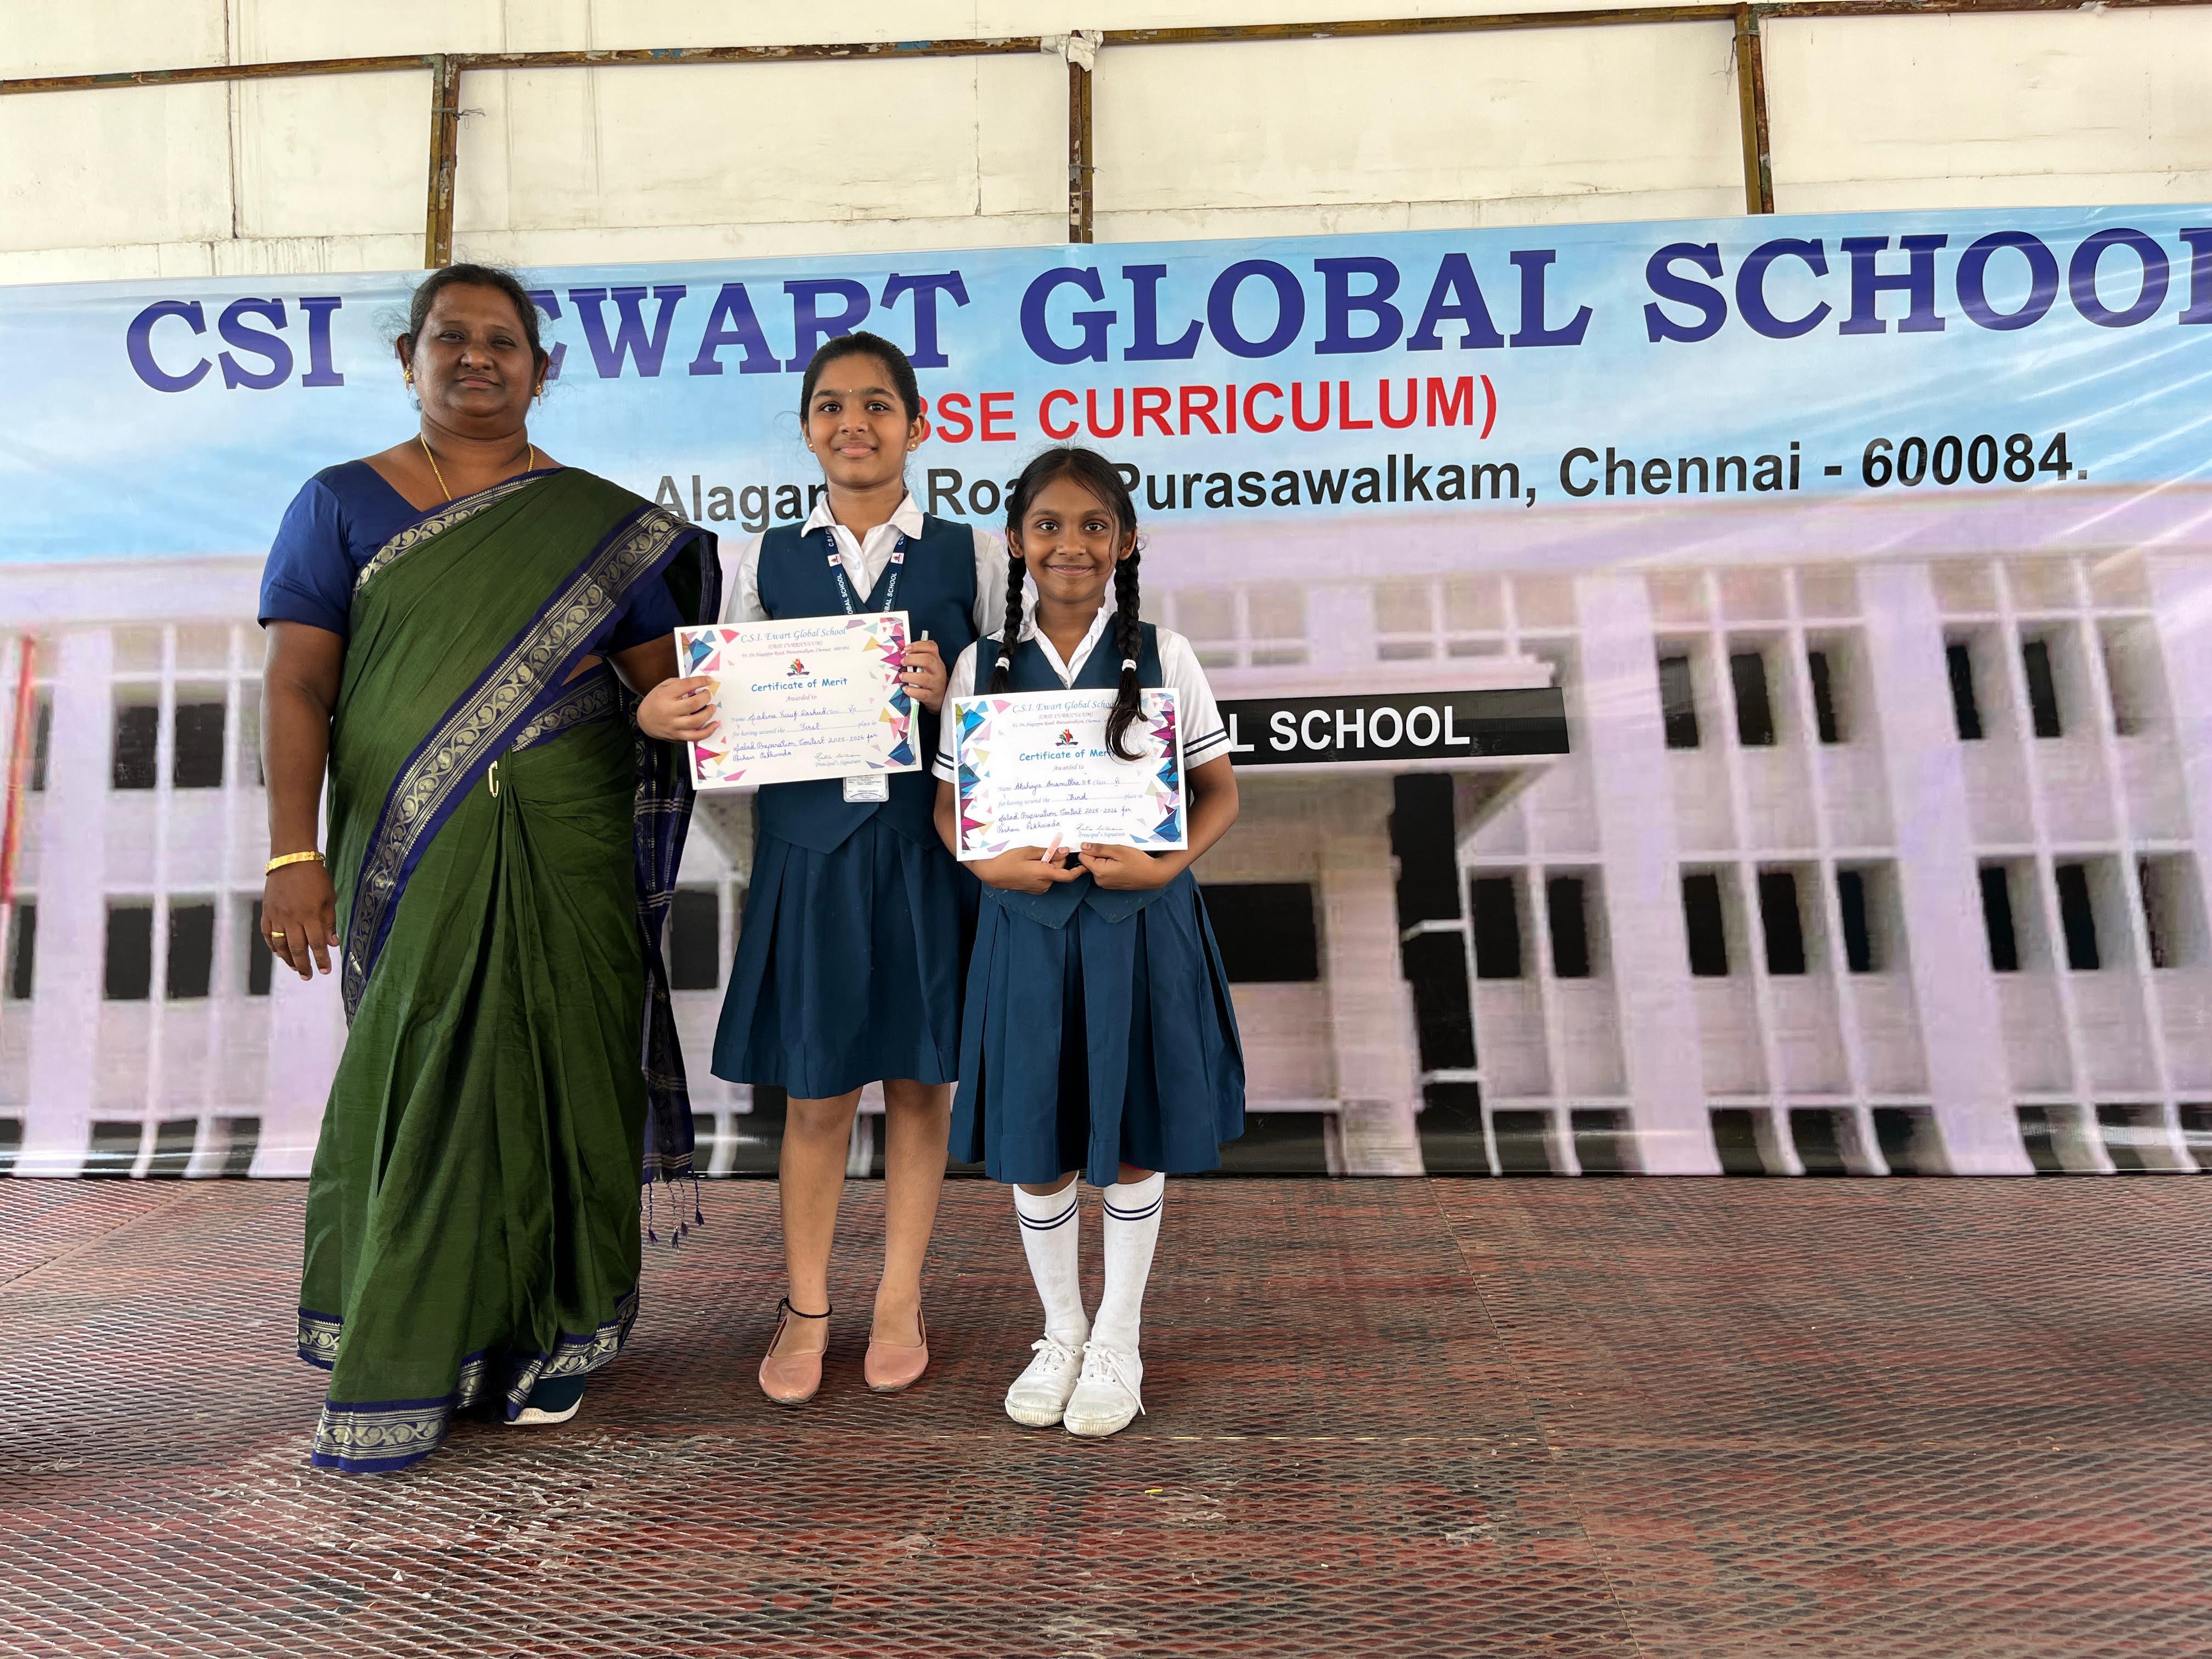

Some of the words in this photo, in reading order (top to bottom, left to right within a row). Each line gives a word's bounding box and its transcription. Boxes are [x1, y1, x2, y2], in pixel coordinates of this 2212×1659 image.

[127, 297, 345, 393] CSI
[1019, 249, 1593, 365] GLOBAL
[1039, 374, 1497, 439] CURRICULUM)
[1559, 442, 1800, 497] Chennai
[1824, 464, 1842, 478] -
[1861, 432, 2089, 488] 600084.
[837, 573, 848, 597] SCHOOL
[887, 572, 897, 597] SCHOOL
[741, 634, 762, 643] C.S.I.
[765, 632, 791, 641] Ewart
[793, 628, 819, 640] Global
[821, 626, 848, 637] School
[751, 681, 803, 692] Certificate
[807, 679, 817, 688] of
[822, 678, 848, 686] Merit
[786, 693, 810, 702] Awarded
[1012, 704, 1034, 713] C.S.I.
[1064, 701, 1090, 712] Global
[1091, 699, 1115, 709] Schoo
[1269, 706, 1470, 751] SCHOOL
[1019, 751, 1070, 761] Certificate
[1075, 749, 1085, 758] of
[1053, 763, 1077, 771] Awarded
